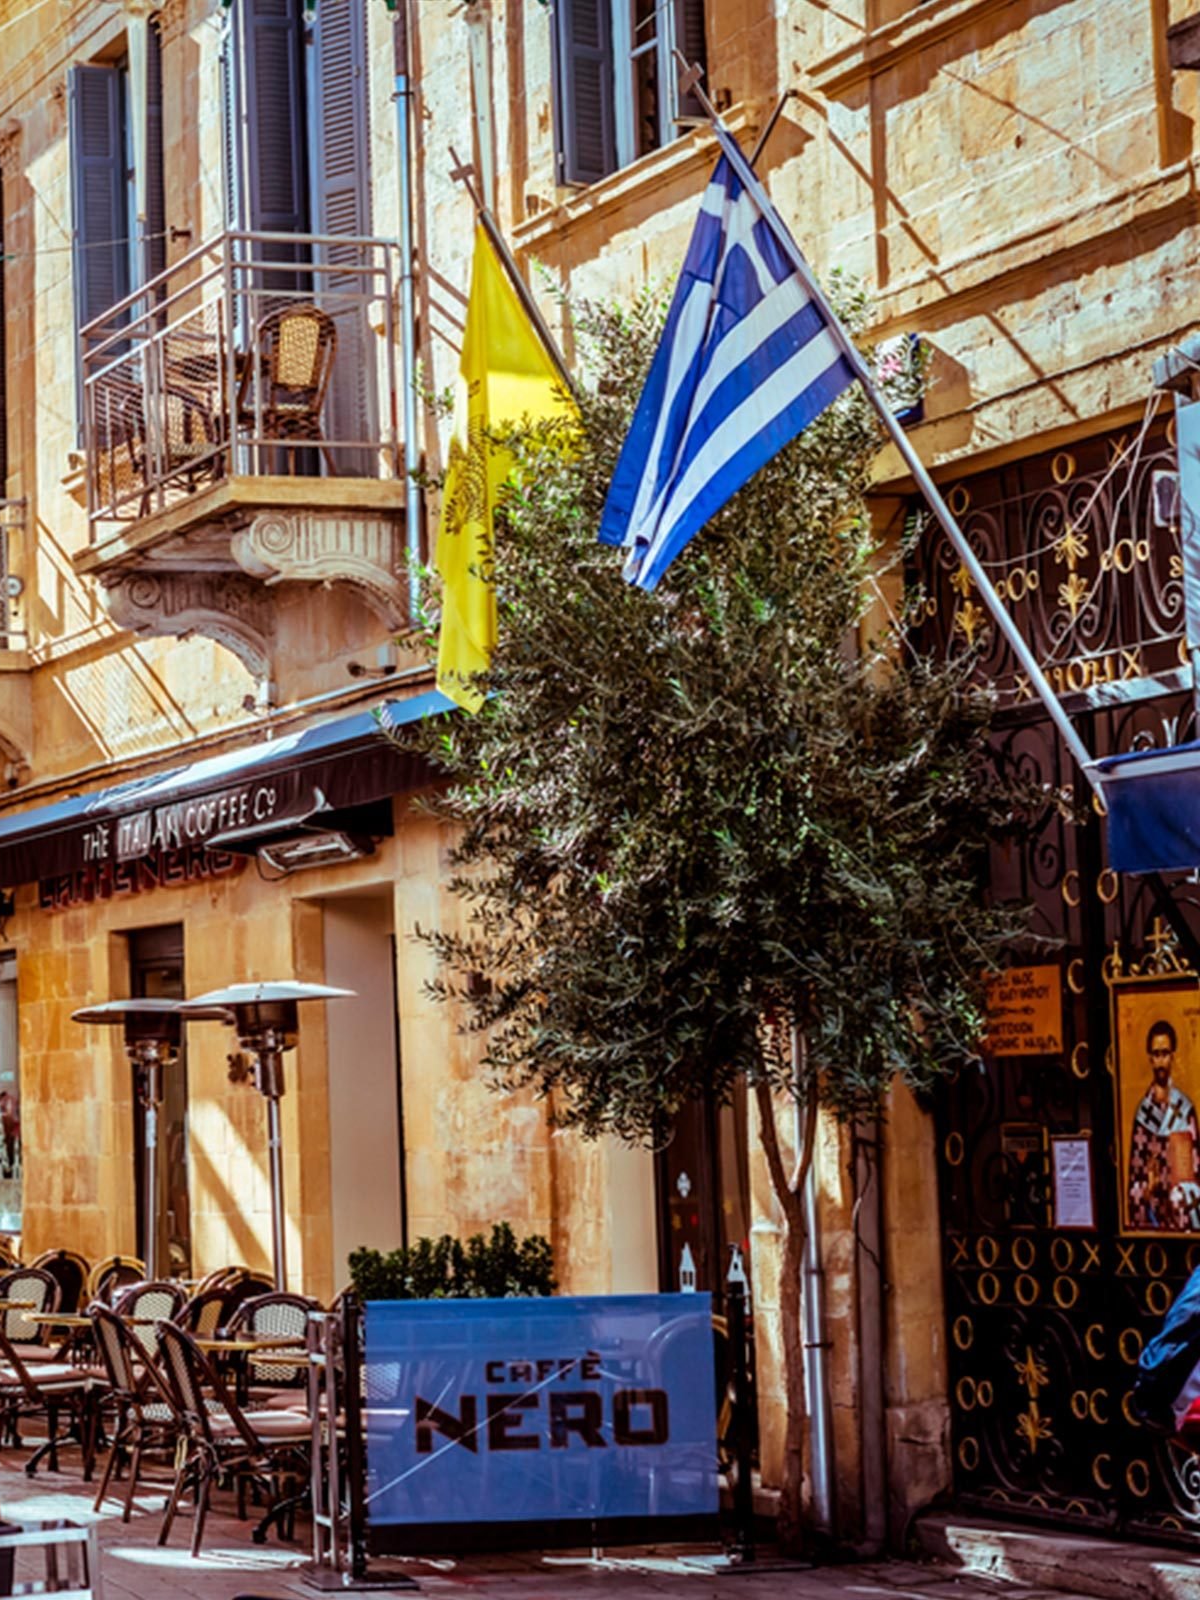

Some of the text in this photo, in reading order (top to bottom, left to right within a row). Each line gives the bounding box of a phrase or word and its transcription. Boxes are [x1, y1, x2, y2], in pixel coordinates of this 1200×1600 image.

[82, 825, 109, 862] THE
[184, 793, 248, 838] COFFEE
[414, 1388, 670, 1455] NERO
